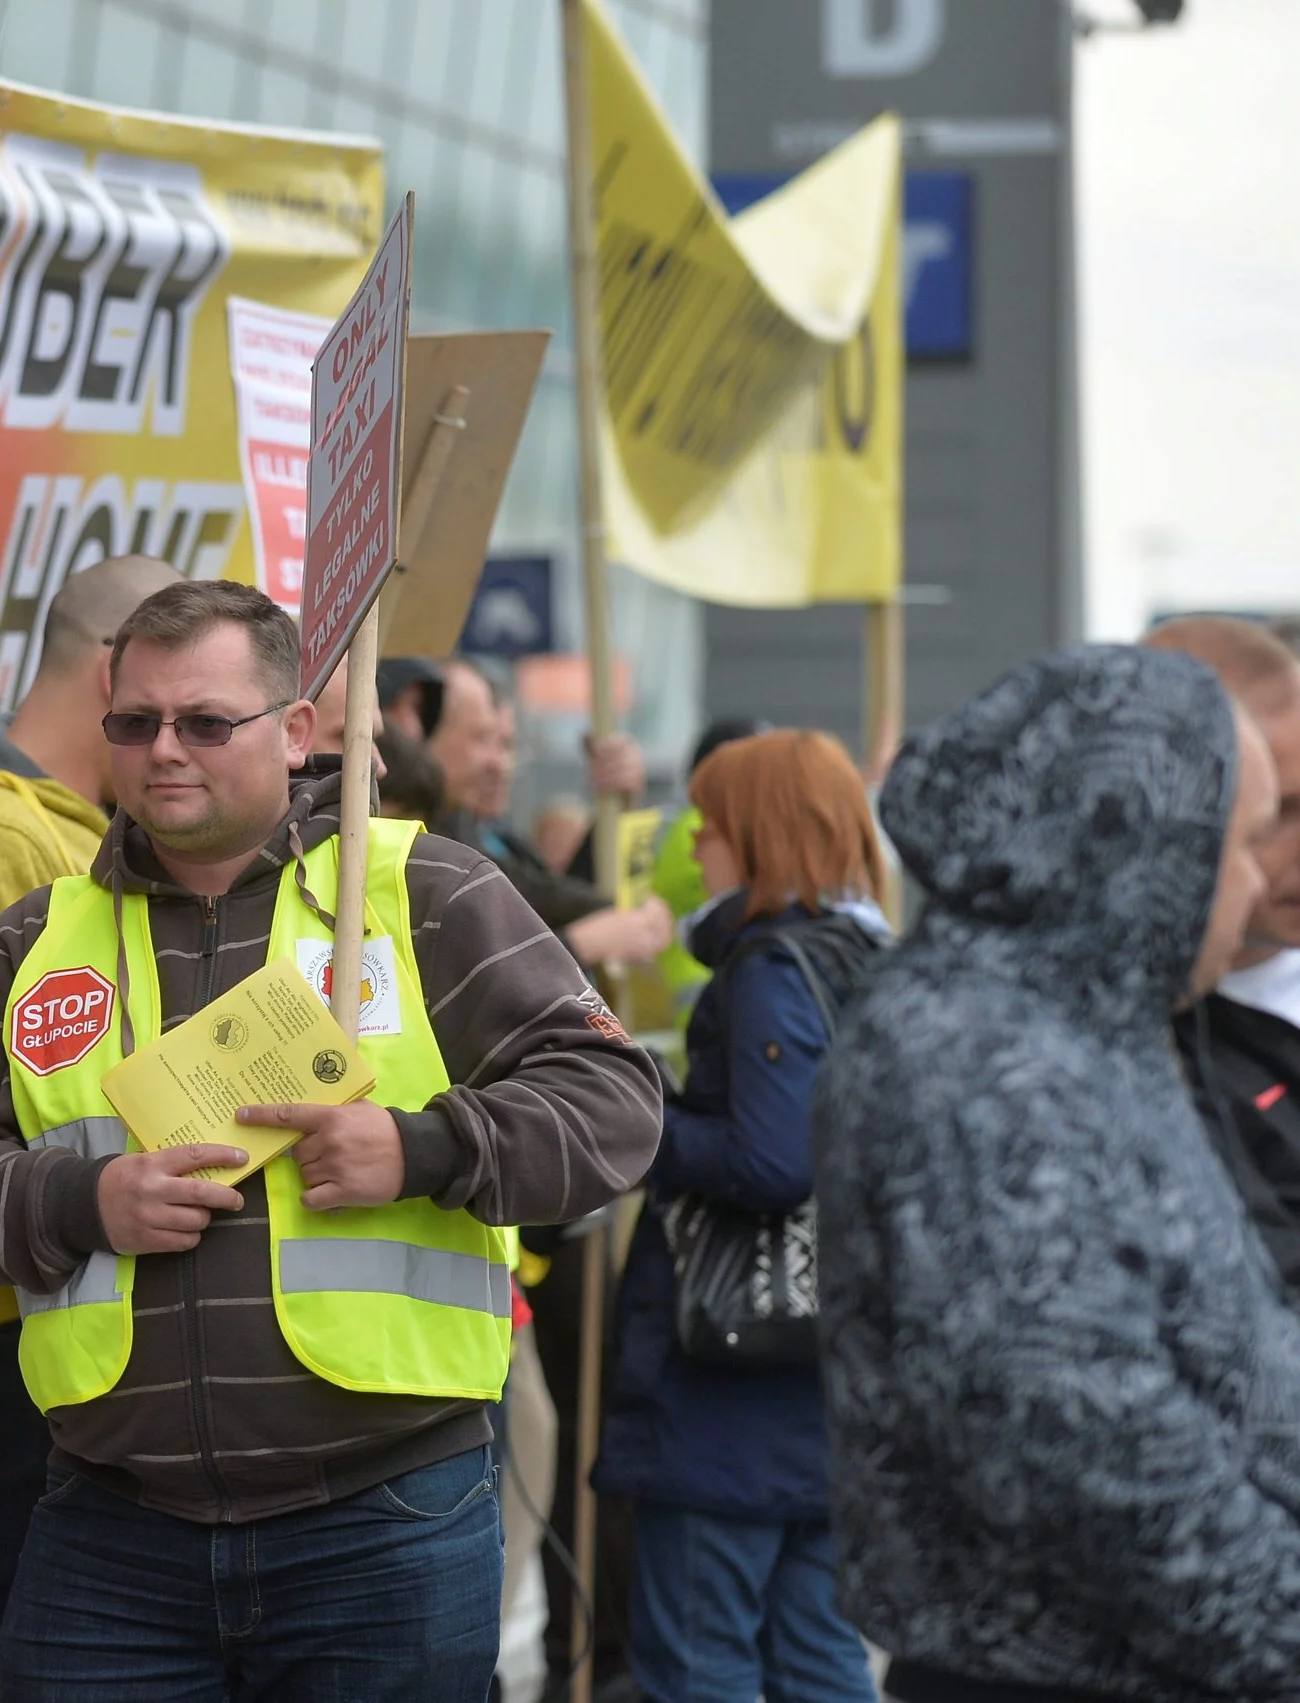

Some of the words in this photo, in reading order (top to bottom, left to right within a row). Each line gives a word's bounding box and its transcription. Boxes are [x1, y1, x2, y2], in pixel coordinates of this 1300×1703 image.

[333, 258, 389, 384] ONLY
[320, 314, 389, 451] LEGAL
[328, 377, 376, 484] TAXI
[314, 479, 381, 610] LEGALNE
[326, 448, 373, 543] TYLKO
[307, 519, 384, 665] TAKSÓWKI
[22, 990, 105, 1030] STOP
[22, 1019, 99, 1049] GŁUPOCIE
